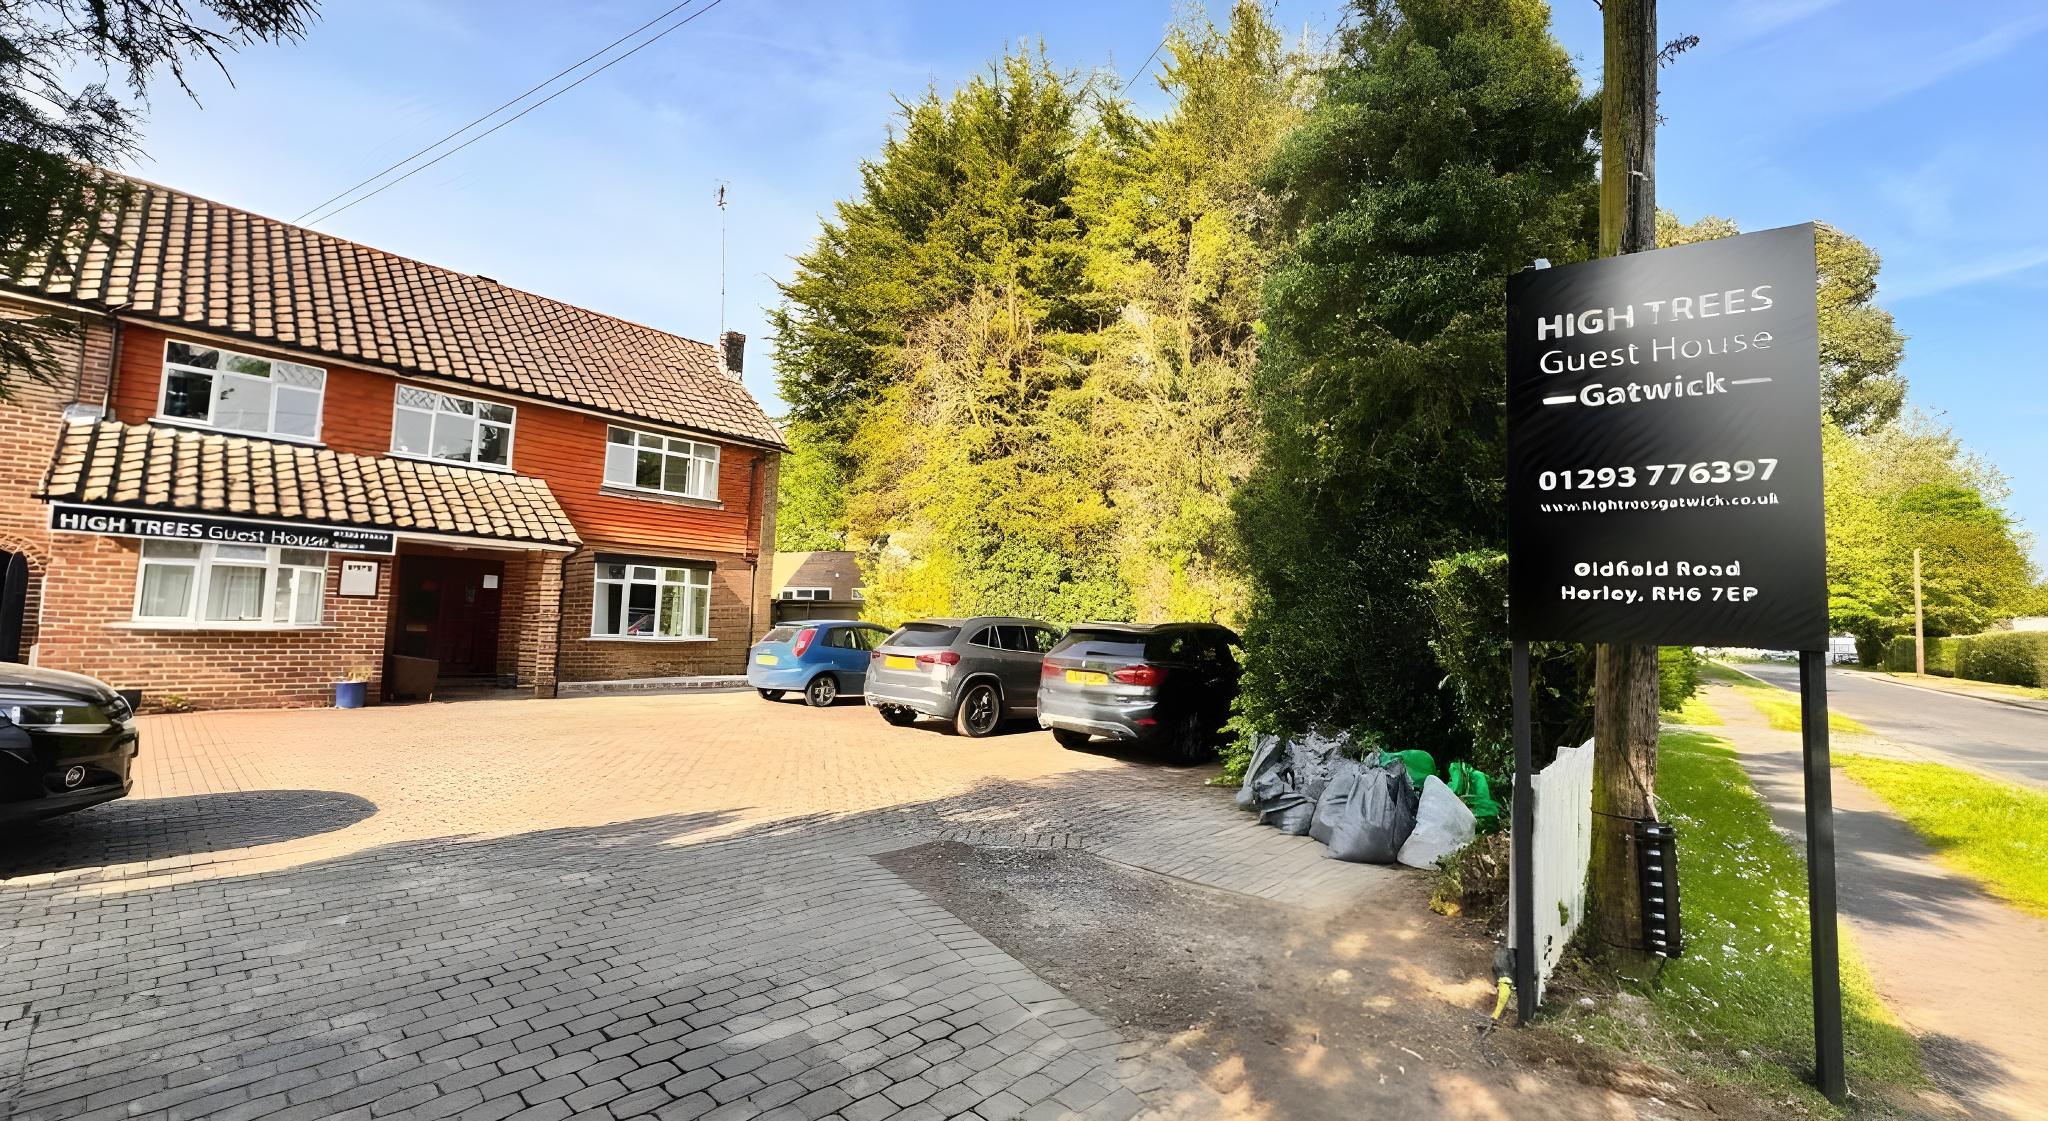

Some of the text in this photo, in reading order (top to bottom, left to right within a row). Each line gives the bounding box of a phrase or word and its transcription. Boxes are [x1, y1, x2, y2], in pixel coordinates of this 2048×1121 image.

[1537, 284, 1774, 341] HIGH TREES
[1539, 330, 1773, 374] Guest House
[1579, 372, 1728, 408] Gatwick
[1538, 458, 1778, 491] 01293 776397
[60, 513, 126, 533] HIGH
[131, 519, 203, 538] TREES
[208, 526, 265, 544] Guest
[271, 530, 329, 548] House
[1574, 560, 1741, 577] Oldfield Road
[1561, 585, 1759, 605] Horley, RH6 7EP
